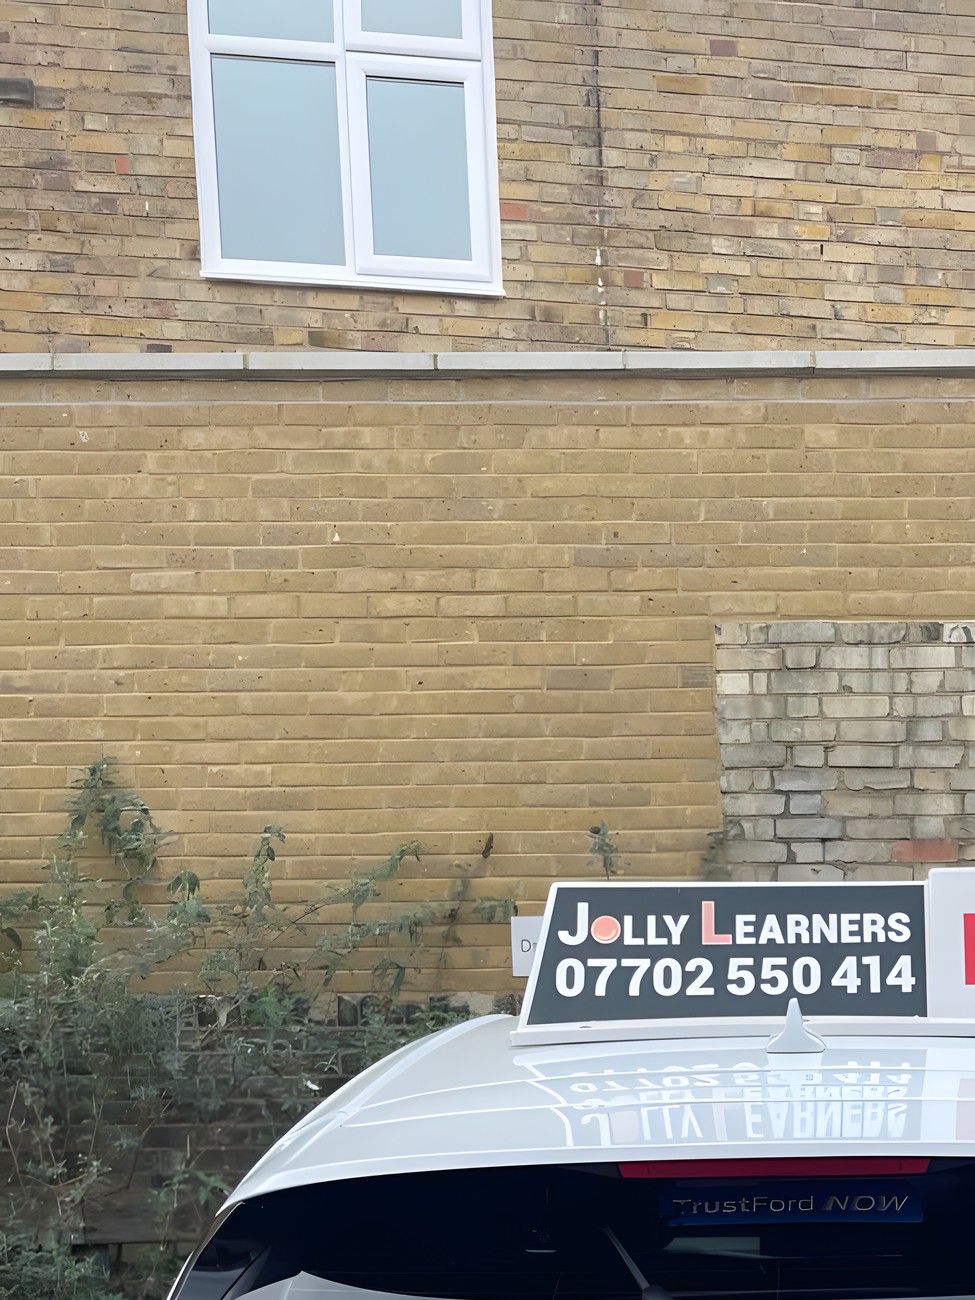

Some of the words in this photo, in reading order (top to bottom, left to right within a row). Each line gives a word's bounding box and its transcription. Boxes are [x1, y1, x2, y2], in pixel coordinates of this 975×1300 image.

[557, 901, 691, 946] JOLLY
[701, 900, 911, 946] LEARNERS
[555, 957, 715, 997] 07702
[726, 955, 822, 996] 550
[830, 954, 916, 994] 414
[673, 1195, 814, 1214] TrustFord
[822, 1195, 909, 1212] NOW
